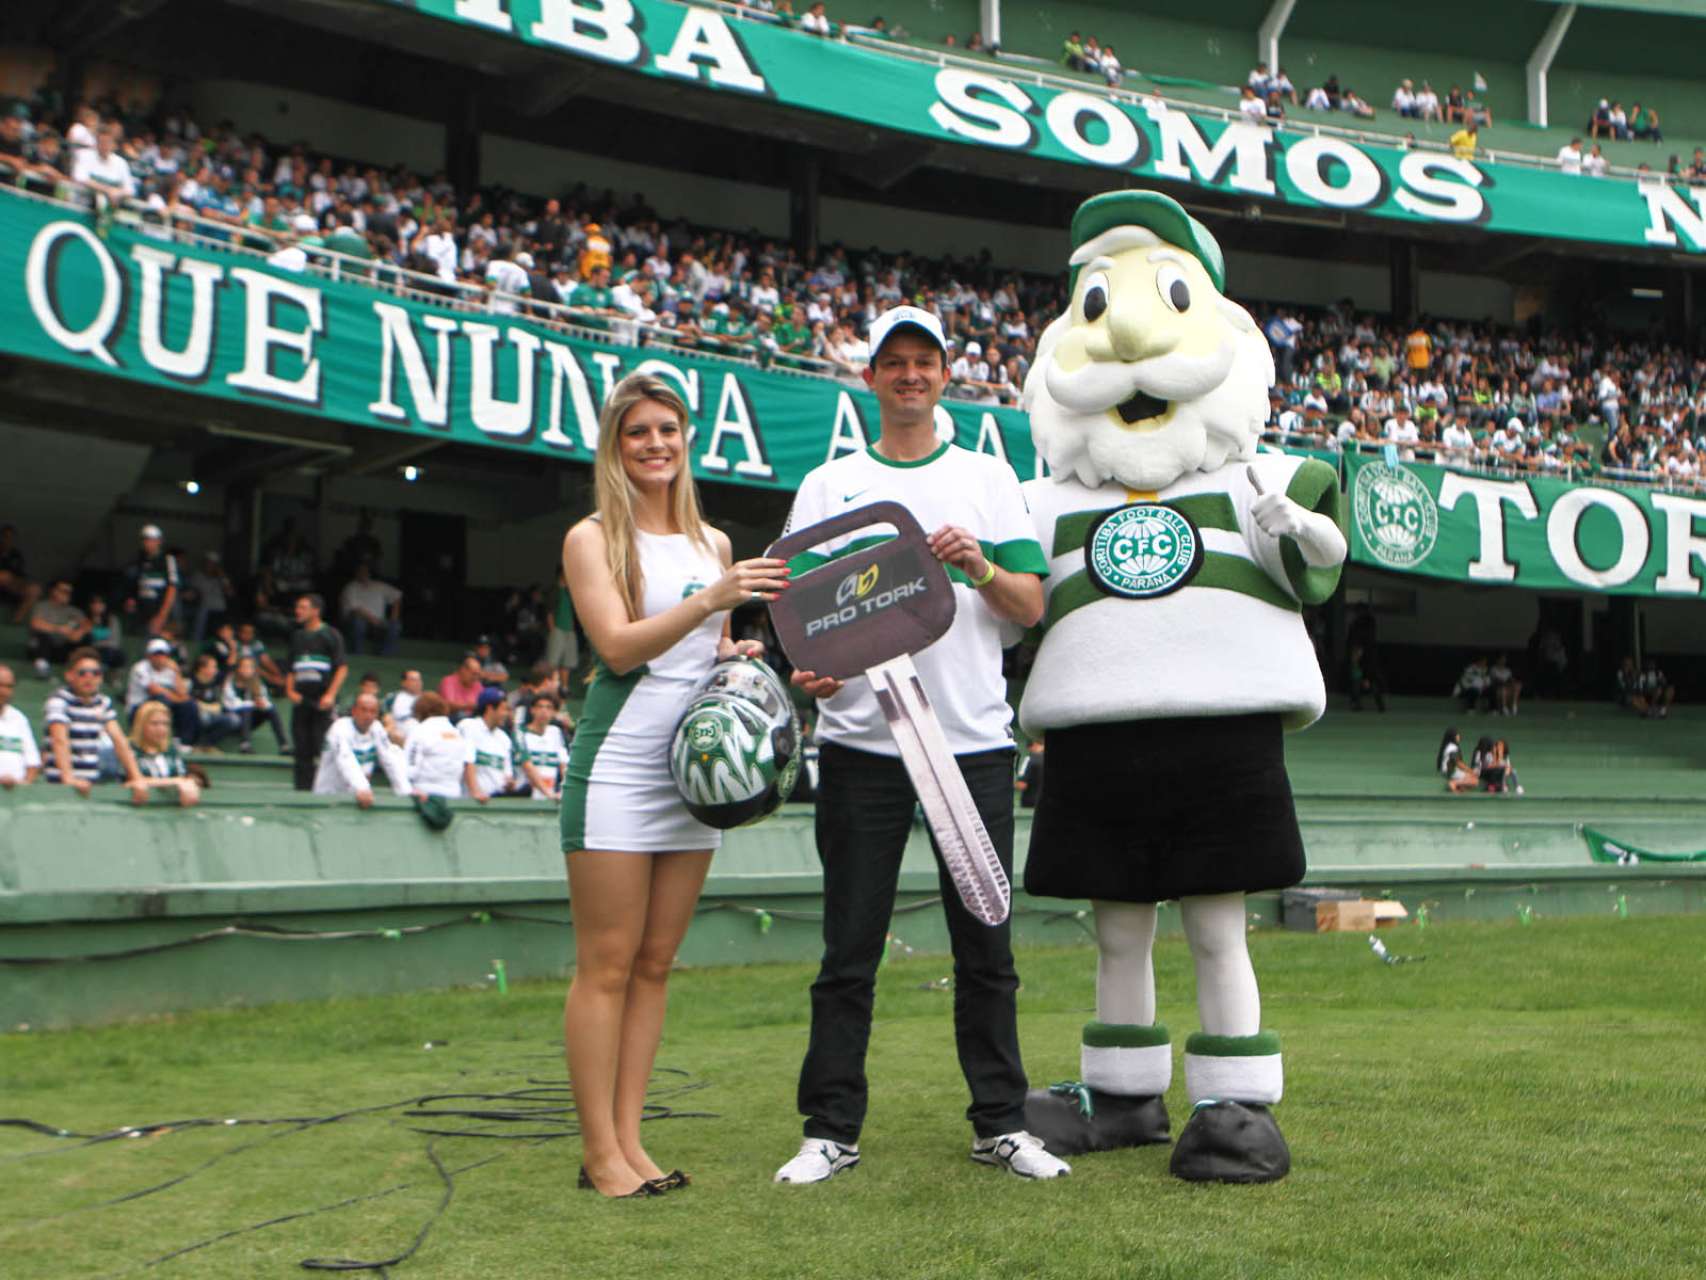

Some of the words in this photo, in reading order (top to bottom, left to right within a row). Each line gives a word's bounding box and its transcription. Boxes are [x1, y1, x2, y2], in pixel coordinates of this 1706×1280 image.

[929, 68, 1486, 221] SOMOS
[26, 220, 324, 401] QUE
[1096, 521, 1117, 576] CORITIBA
[1156, 510, 1184, 532] BALL
[1177, 534, 1190, 565] CLUB
[1113, 534, 1172, 560] CFC
[806, 606, 857, 637] PRO
[860, 576, 927, 613] TORK
